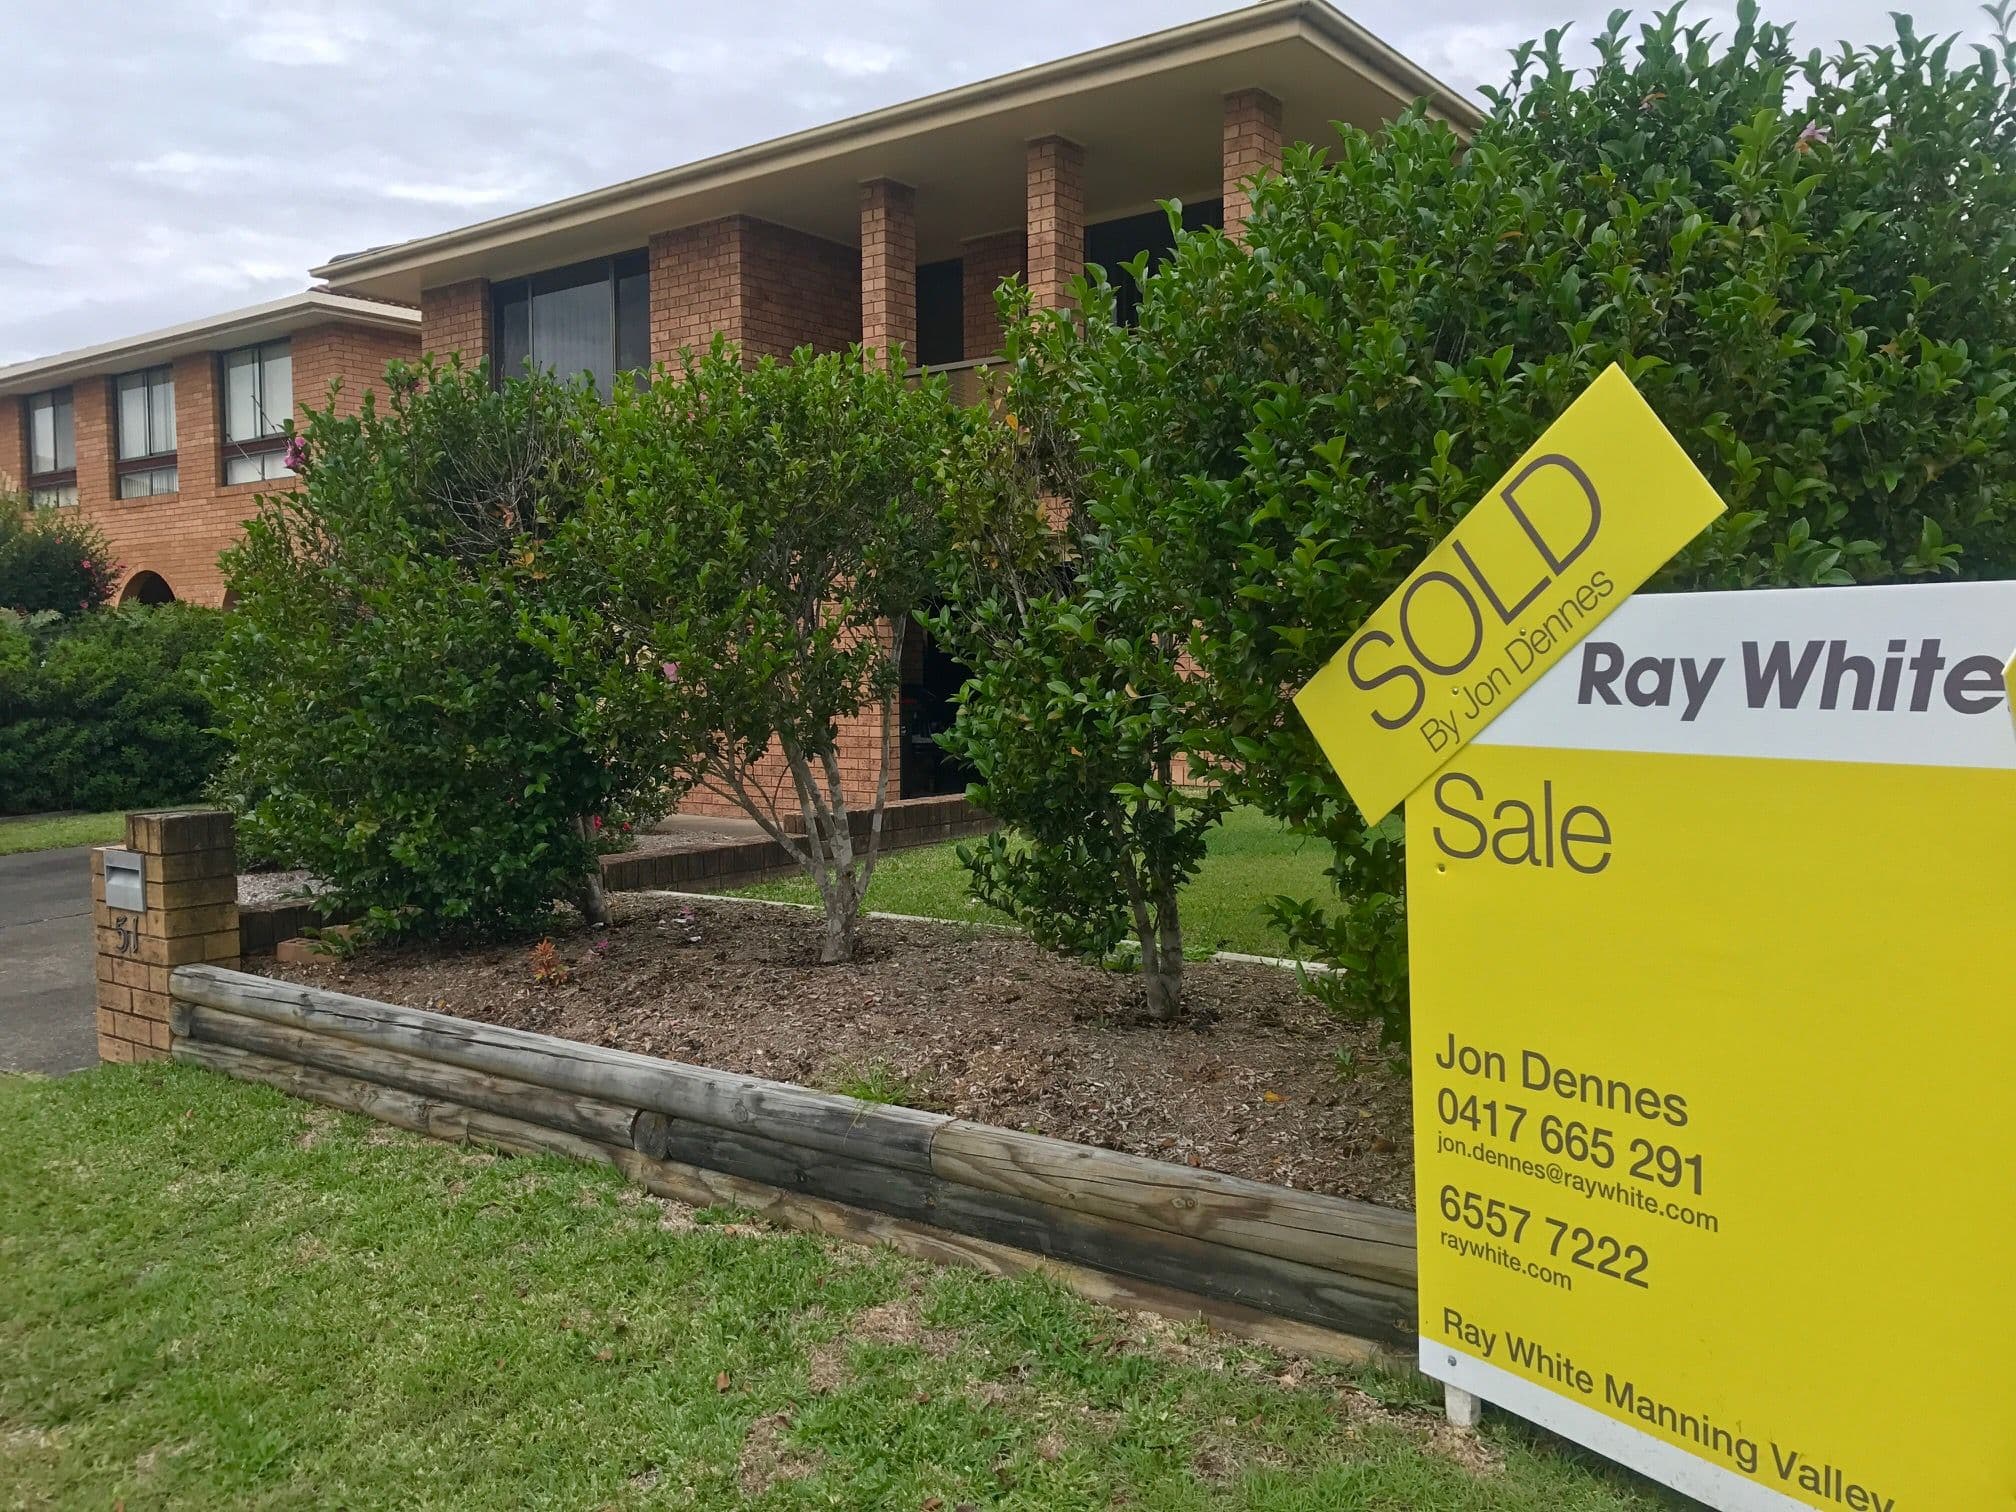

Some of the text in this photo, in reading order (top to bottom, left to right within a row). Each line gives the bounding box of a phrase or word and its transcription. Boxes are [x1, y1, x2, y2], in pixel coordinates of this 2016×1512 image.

[1348, 453, 1602, 730] SOLD
[1421, 570, 1614, 752] By Jon Dennes
[1577, 638, 2006, 721] Ray White
[1433, 772, 1612, 874] Sale
[117, 914, 139, 954] 51
[1436, 1032, 1688, 1127] Jon Dennes
[1437, 1131, 1719, 1232] jon.dennes@raywhite.com
[1438, 1087, 1703, 1195] 0417 665 291
[1440, 1184, 1649, 1288] 6557 7222
[1440, 1231, 1572, 1290] raywhite.com
[1443, 1307, 1496, 1357] Ray
[1505, 1332, 1593, 1394] White
[1605, 1374, 1758, 1473] Manning
